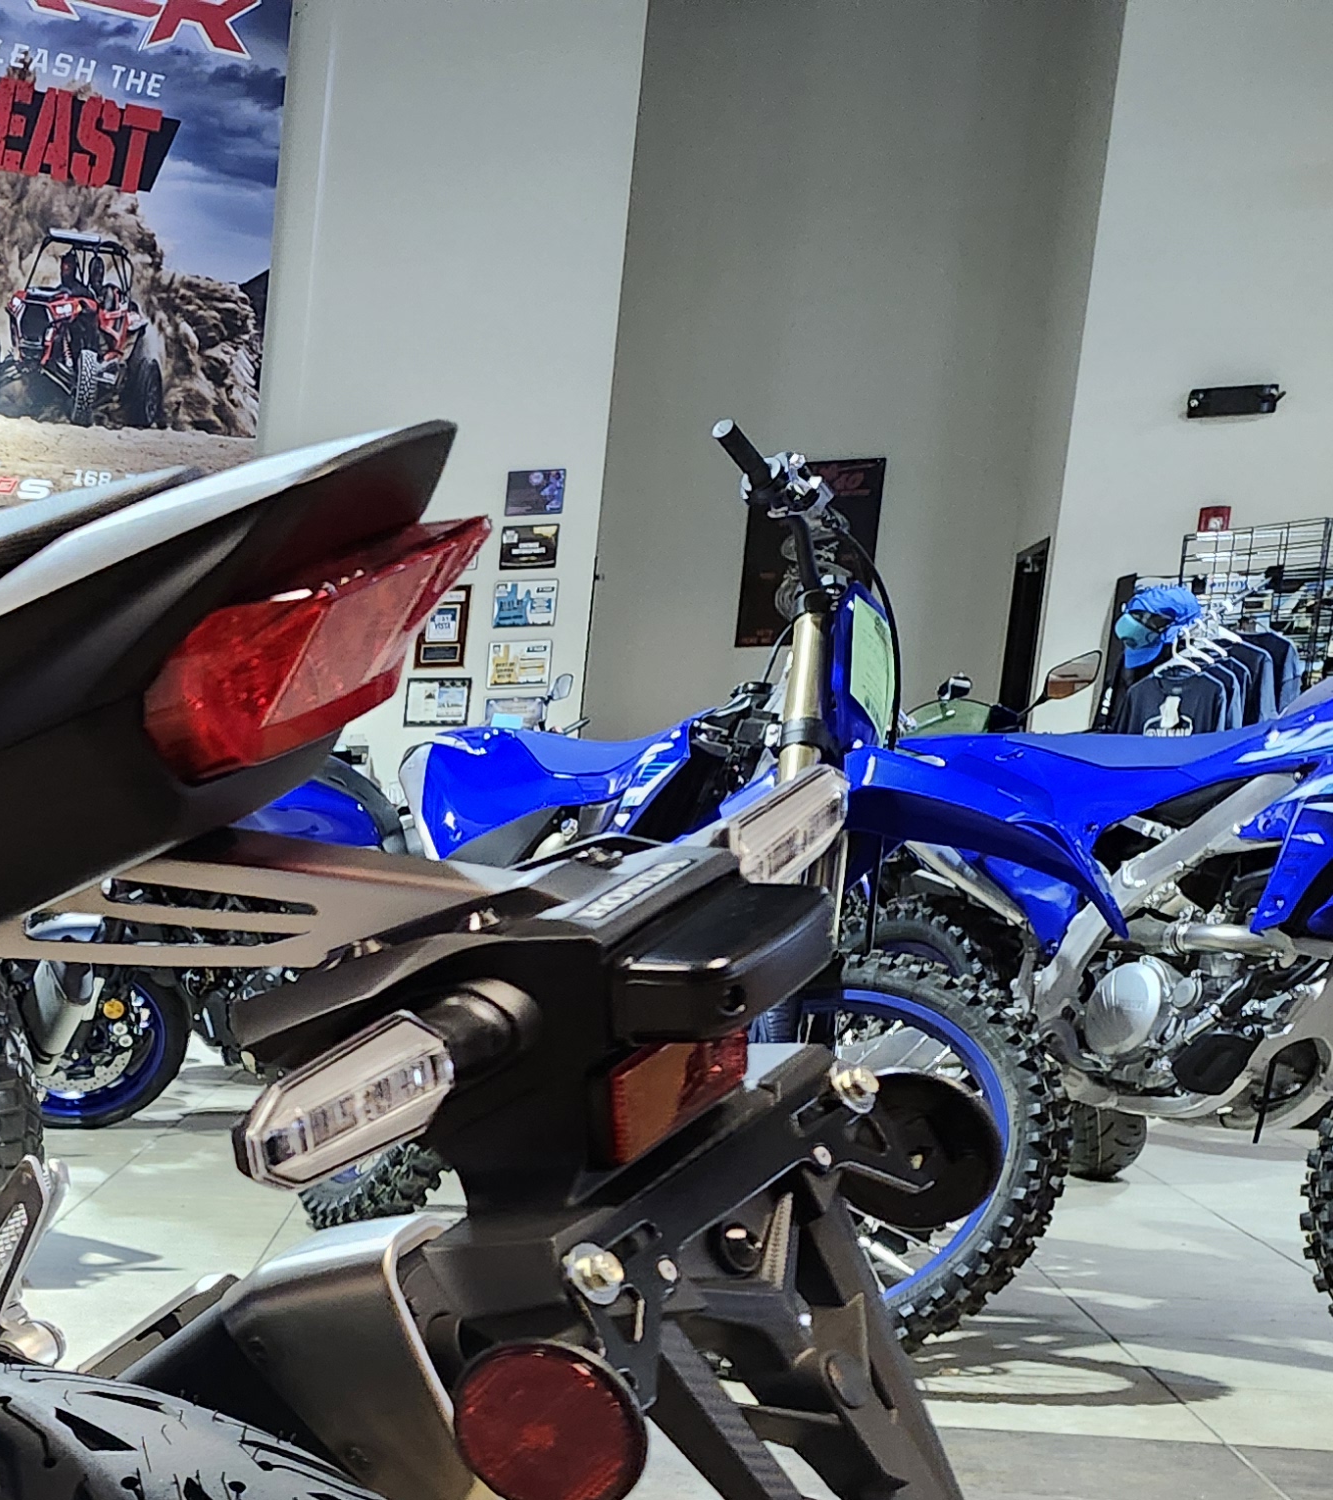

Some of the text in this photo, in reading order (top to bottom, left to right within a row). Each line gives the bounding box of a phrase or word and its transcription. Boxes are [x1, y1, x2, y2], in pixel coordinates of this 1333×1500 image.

[110, 64, 167, 99] THE
[16, 478, 55, 500] S
[71, 468, 114, 487] 168
[570, 858, 692, 920] HONDA
